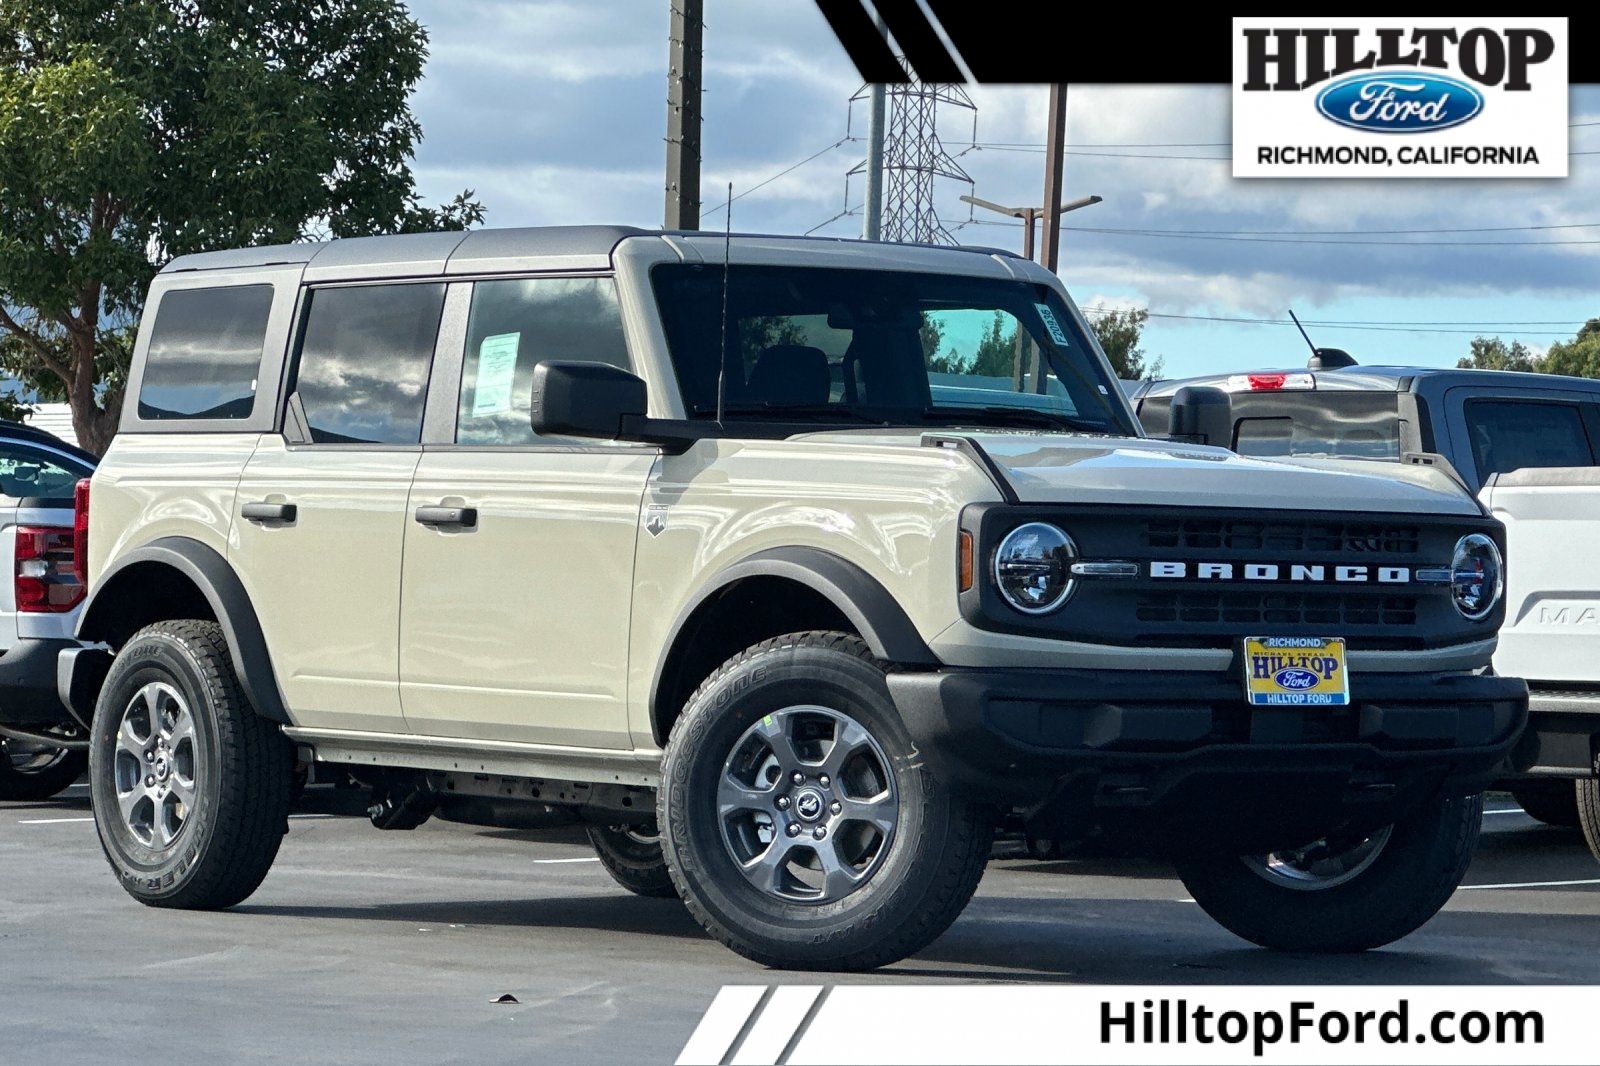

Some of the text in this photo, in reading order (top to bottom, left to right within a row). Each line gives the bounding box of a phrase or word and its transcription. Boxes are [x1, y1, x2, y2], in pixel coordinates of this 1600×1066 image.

[1149, 561, 1410, 583] BRONCO
[1268, 637, 1321, 647] RICHMOND
[1252, 656, 1338, 680] HILLTOP
[1282, 671, 1311, 688] Ford
[1267, 694, 1332, 703] HILLTOP FORD
[668, 664, 769, 872] BRIDGESTONE
